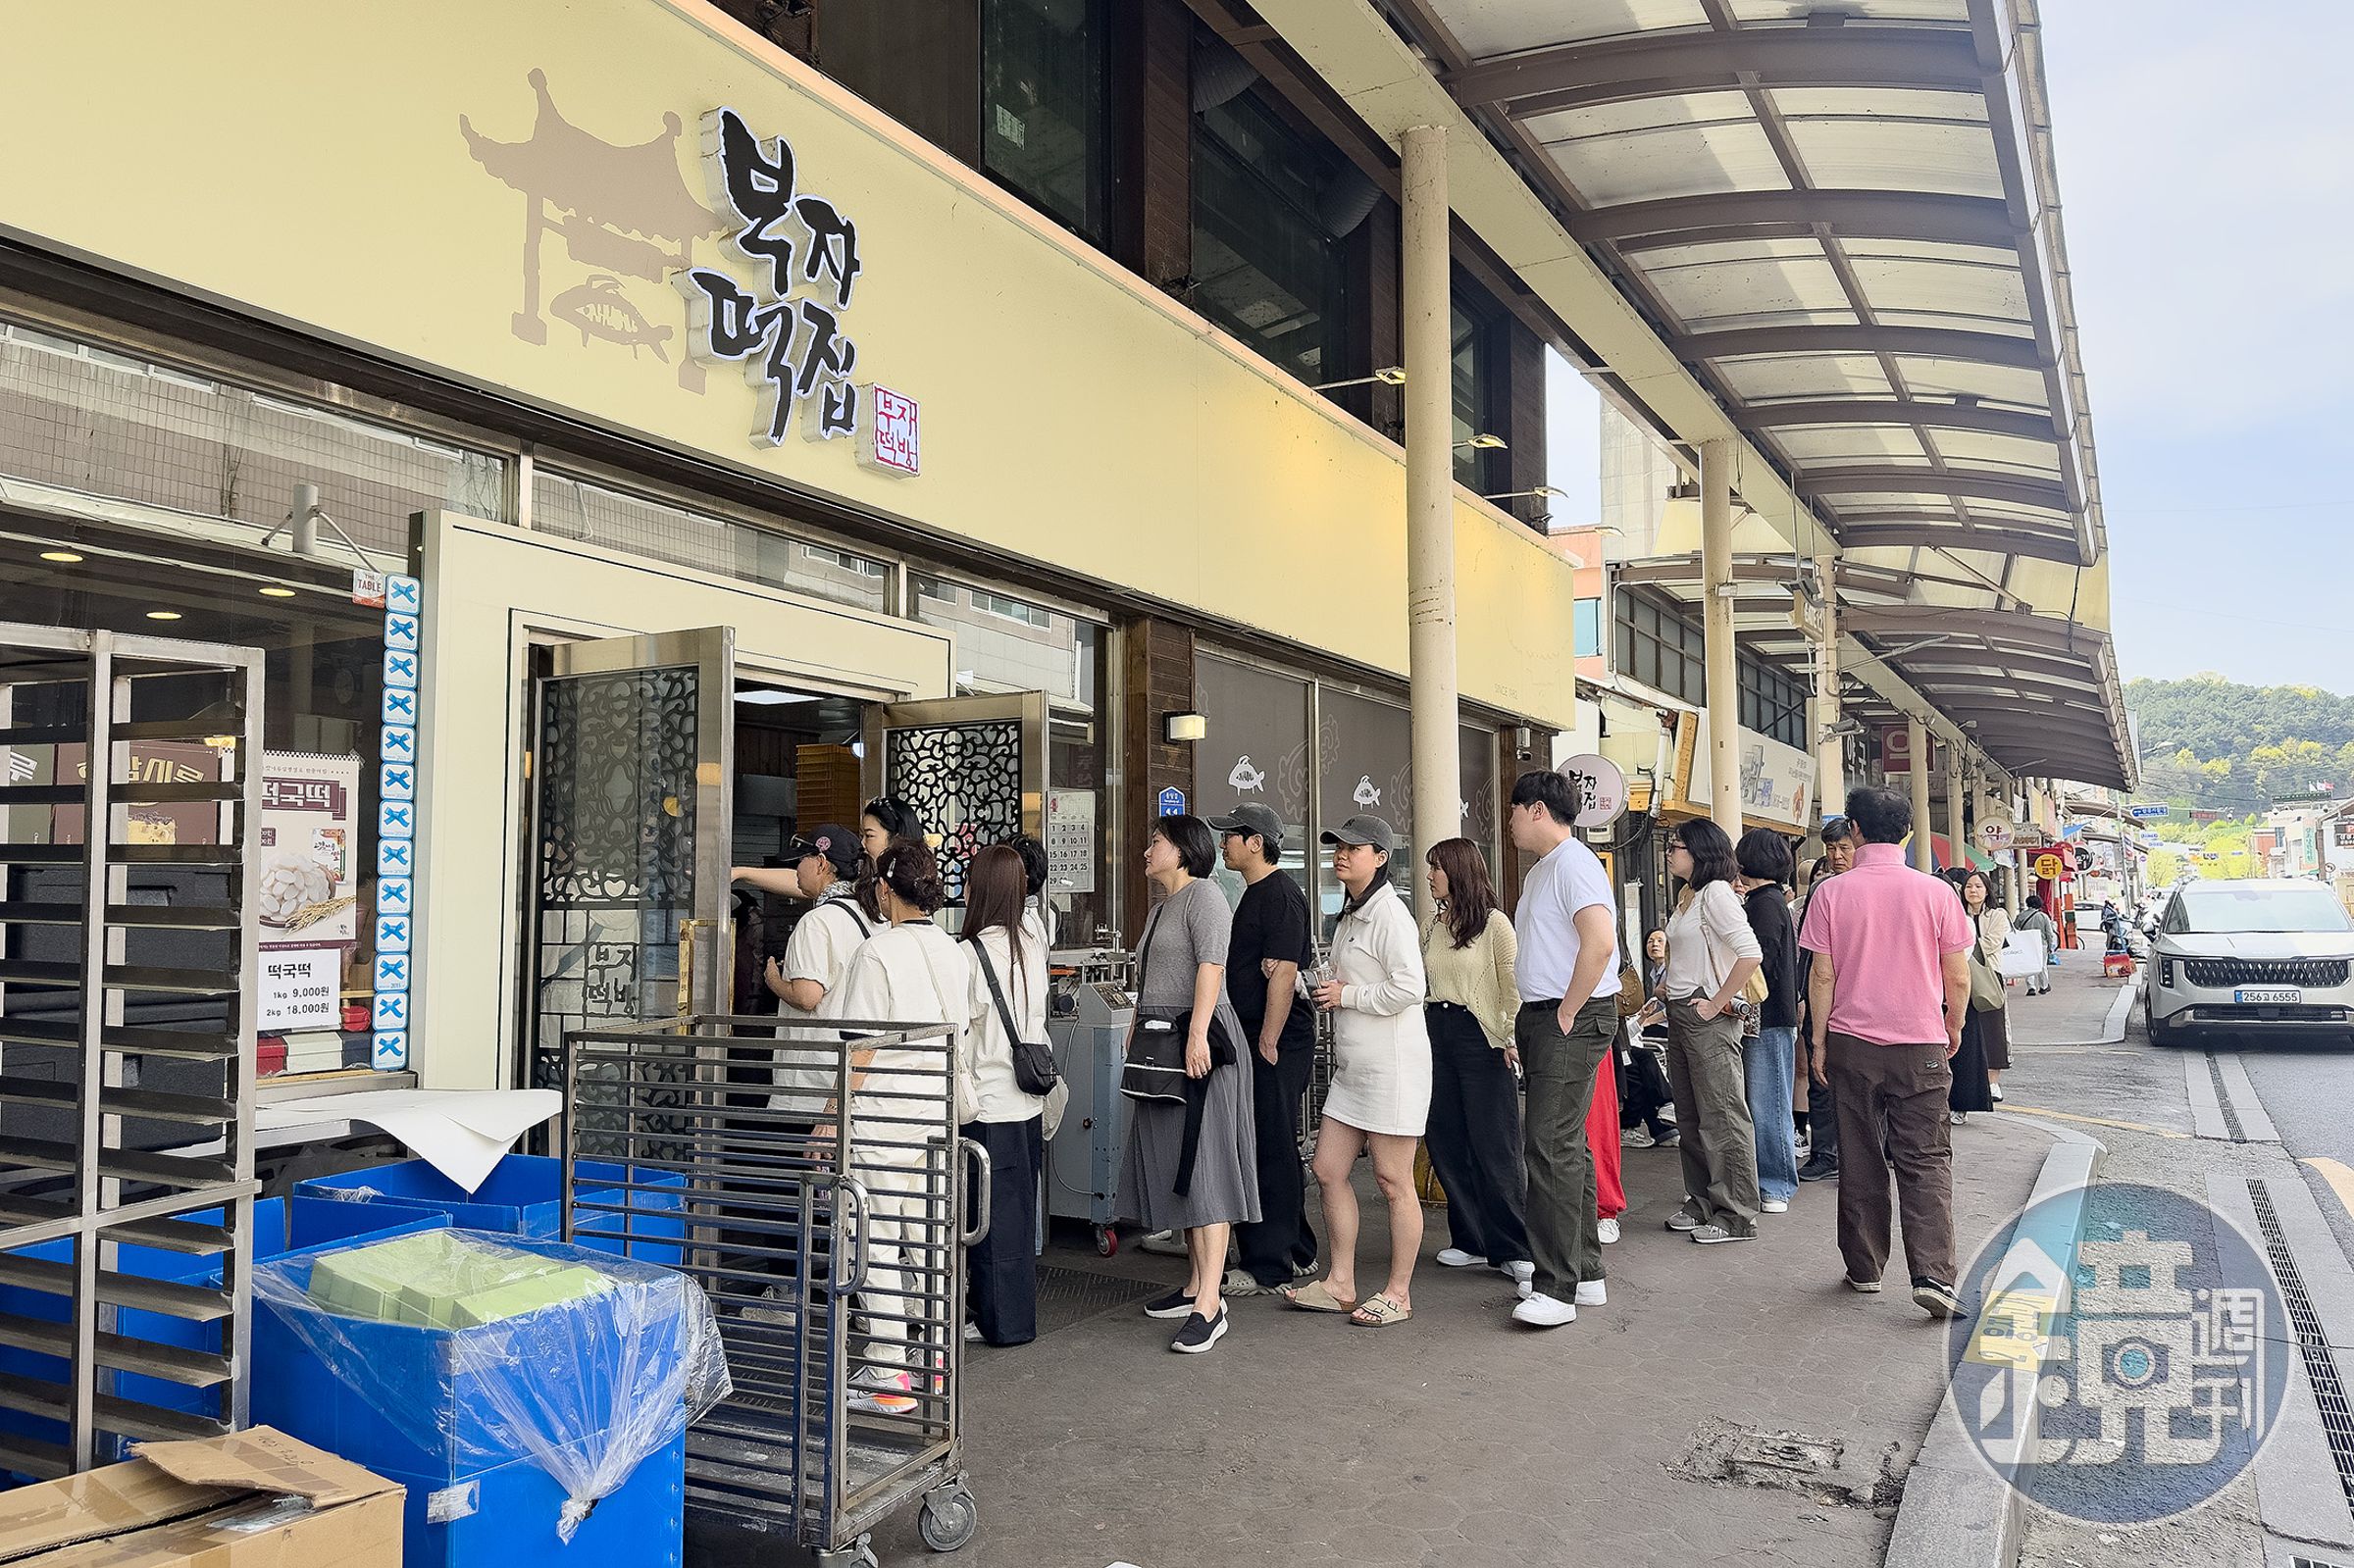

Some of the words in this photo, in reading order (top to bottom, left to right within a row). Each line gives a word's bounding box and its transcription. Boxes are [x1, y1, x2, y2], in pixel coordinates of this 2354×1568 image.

[357, 579, 382, 592] TABLE
[1985, 826, 2003, 840] 약
[2040, 858, 2058, 875] 닭
[268, 962, 312, 980] 떡국떡
[2273, 992, 2297, 1001] 6555
[266, 1008, 281, 1017] 2kg
